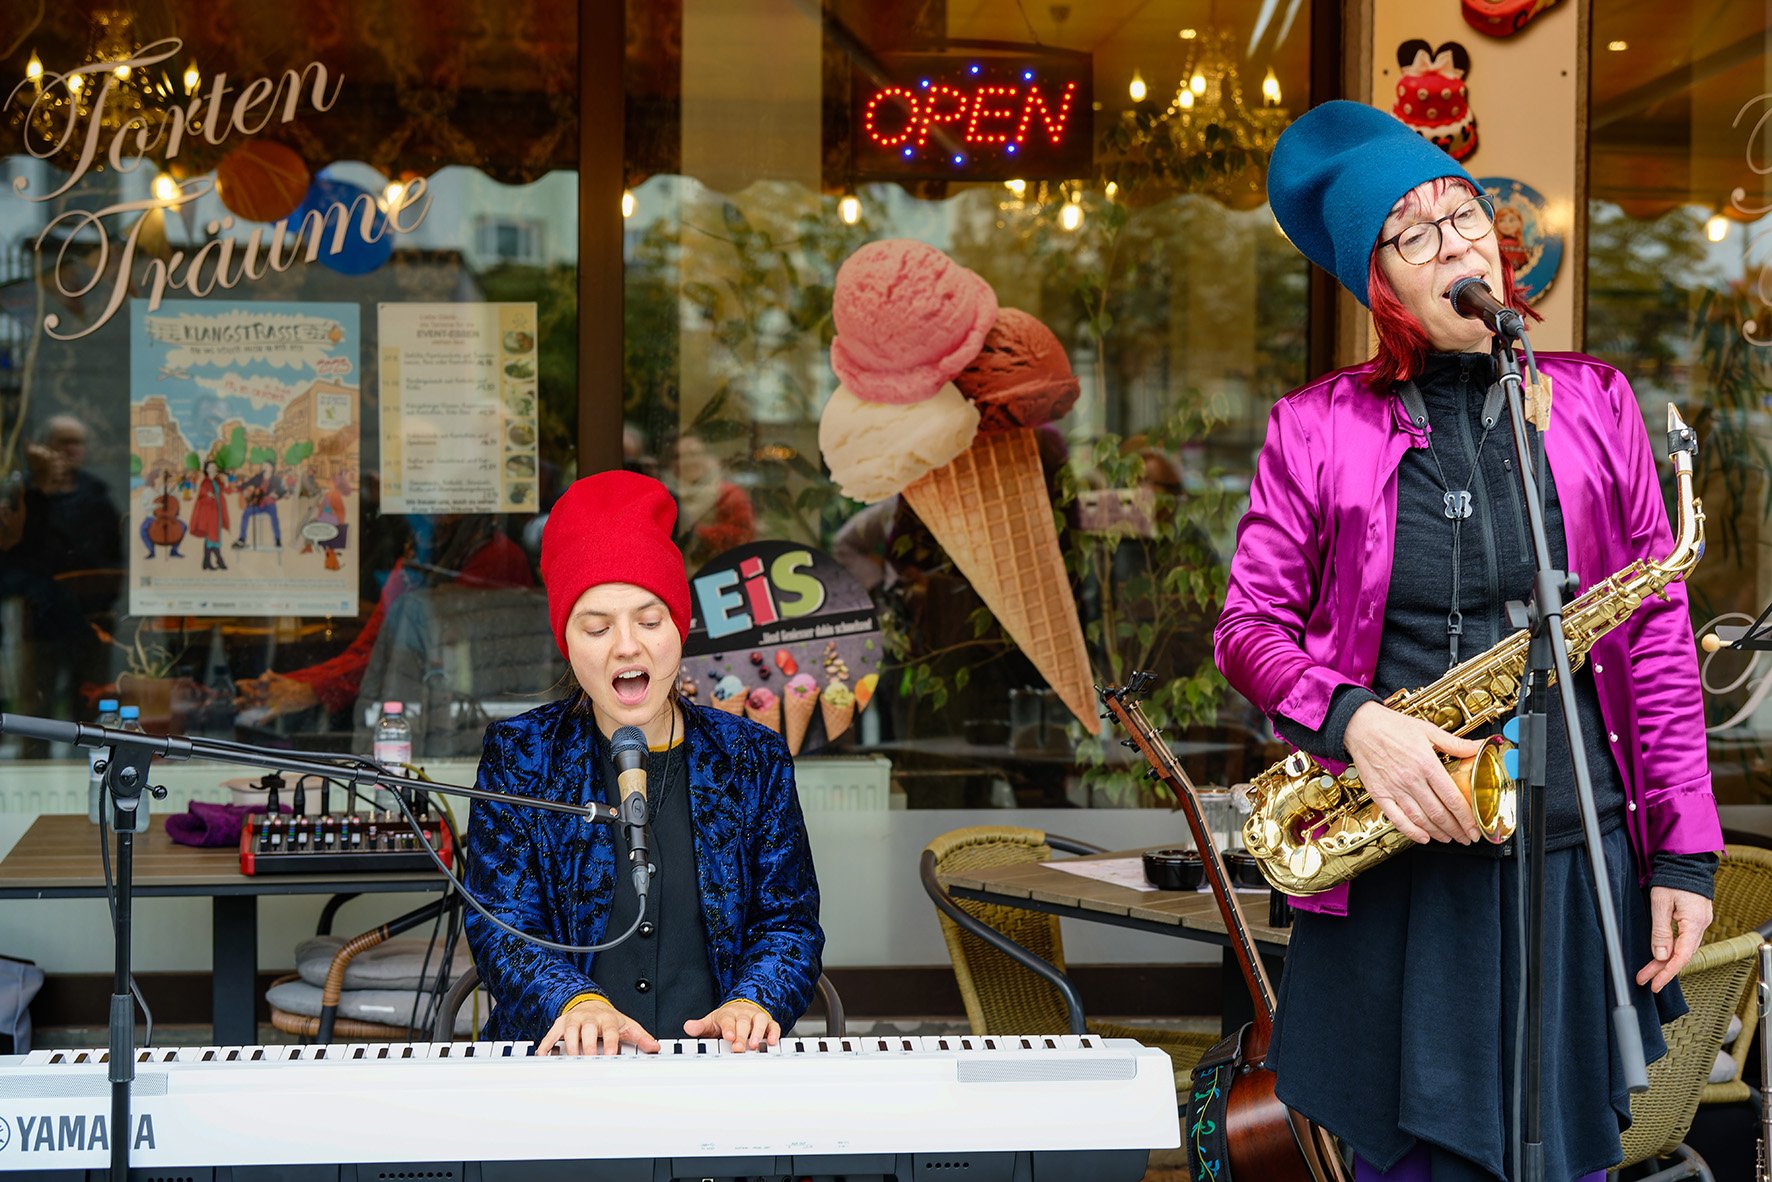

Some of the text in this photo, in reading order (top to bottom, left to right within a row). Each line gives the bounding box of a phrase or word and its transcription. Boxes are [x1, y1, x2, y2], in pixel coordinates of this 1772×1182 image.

[3, 37, 346, 203] Torten
[866, 82, 1076, 145] OPEN
[35, 176, 433, 341] Träume
[16, 1114, 156, 1152] YAMAA
